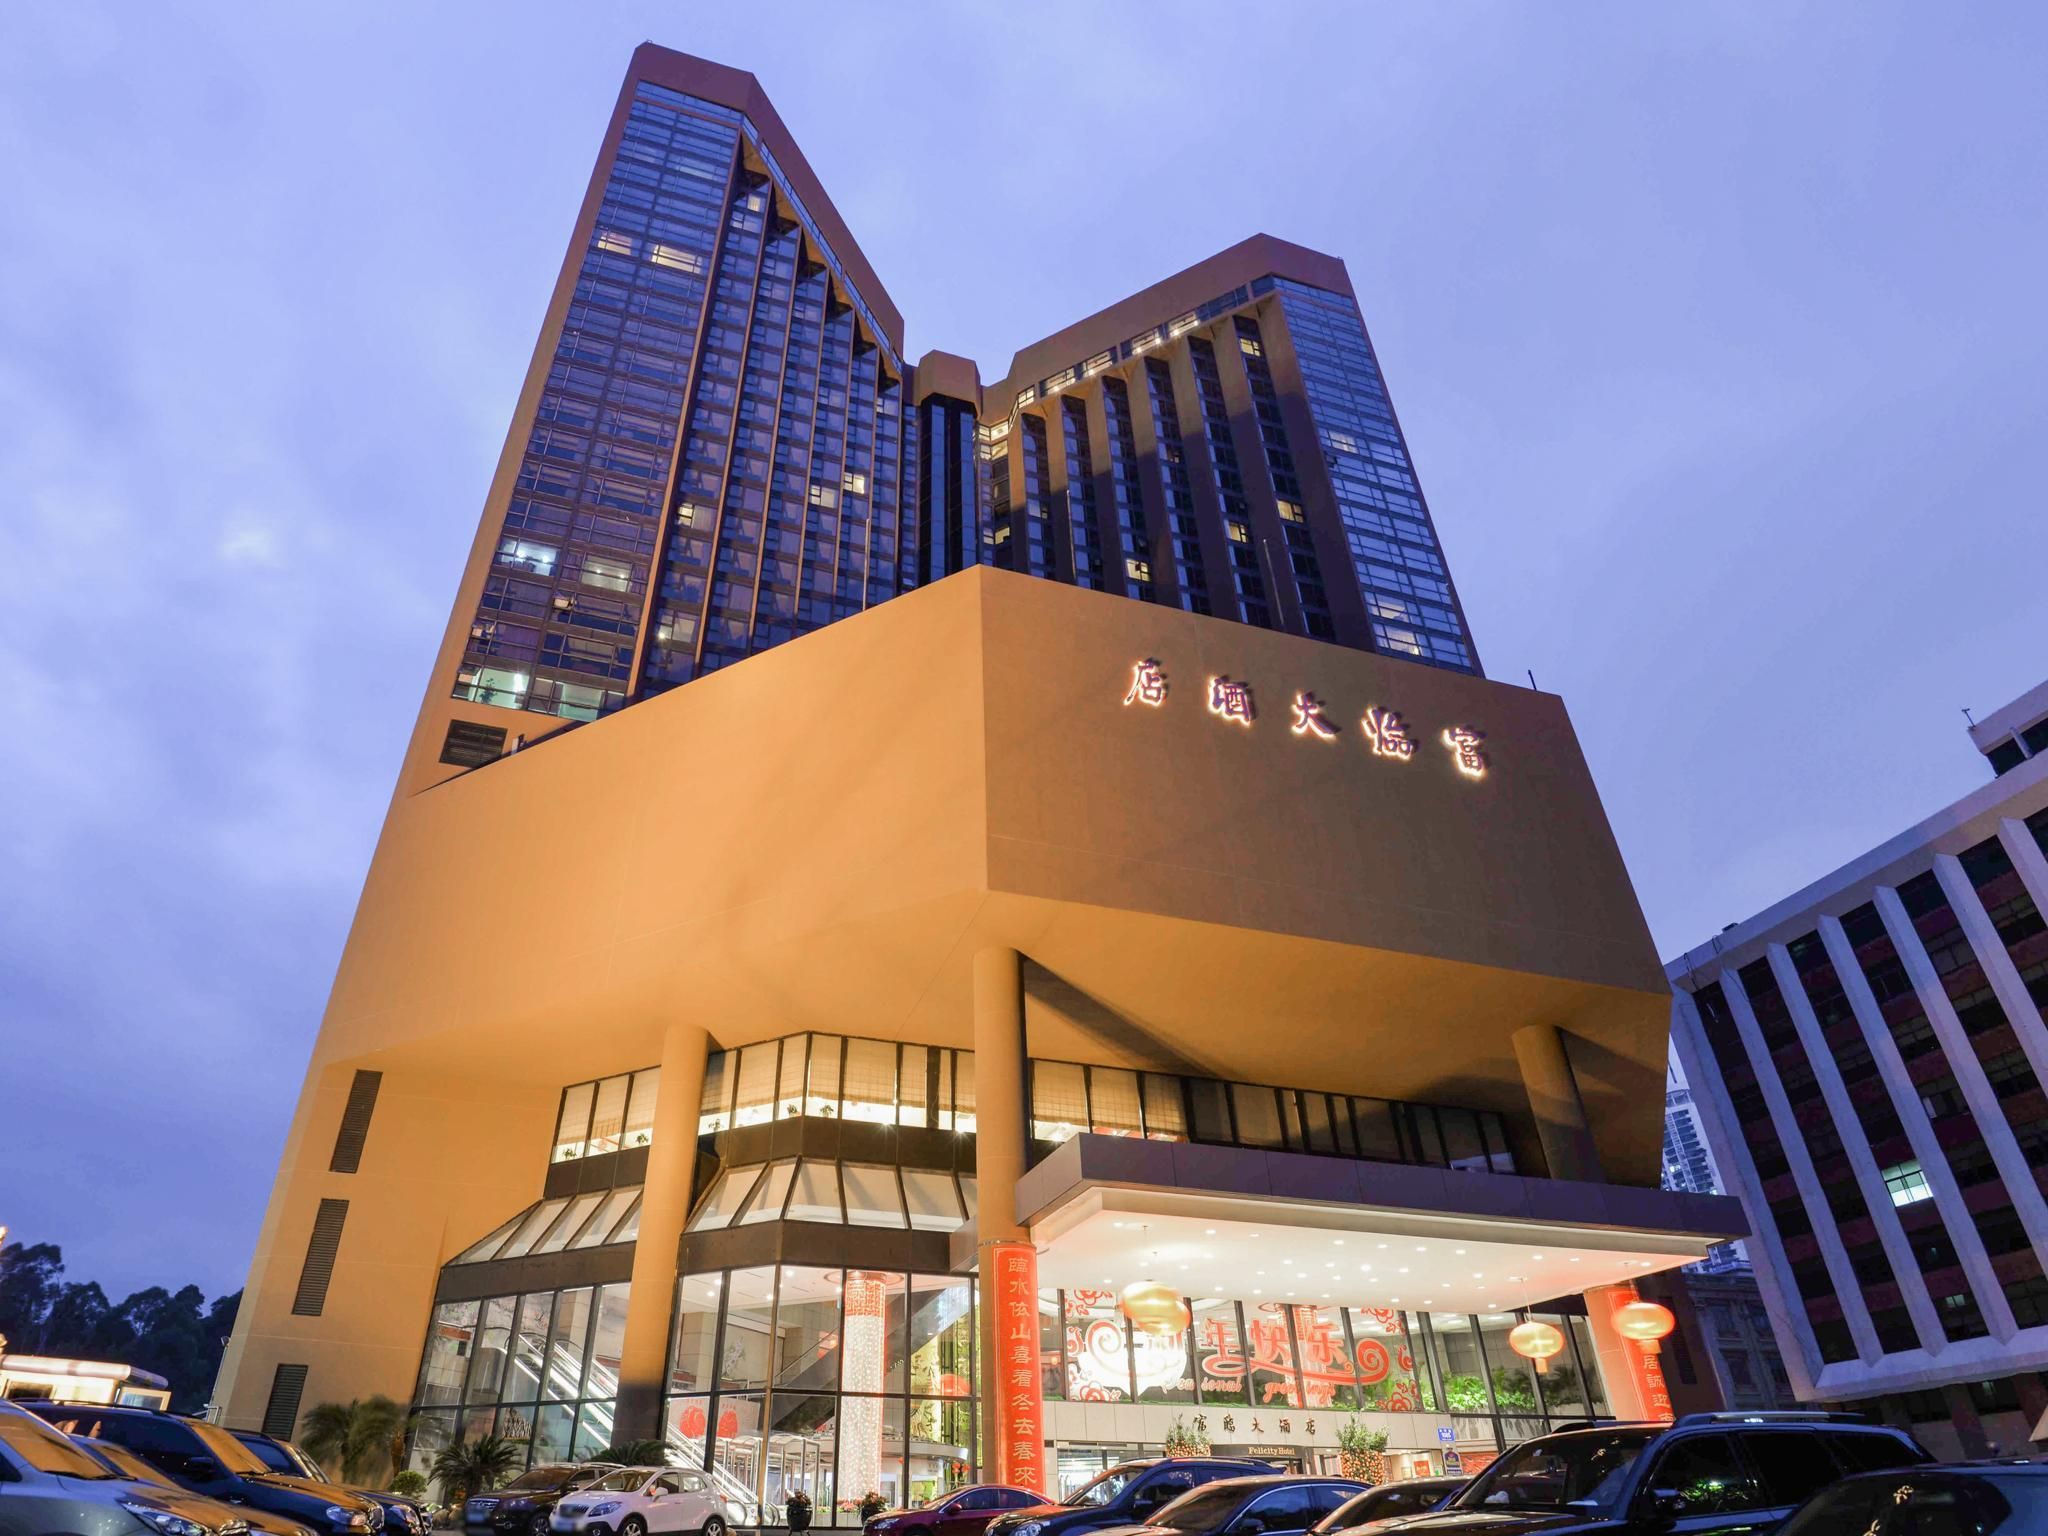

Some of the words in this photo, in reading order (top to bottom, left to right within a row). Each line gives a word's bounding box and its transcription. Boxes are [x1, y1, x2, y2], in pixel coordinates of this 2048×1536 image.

[1263, 1381, 1336, 1404] greeings
[1248, 1446, 1278, 1456] Felicity
[1278, 1447, 1295, 1456] Hotel
